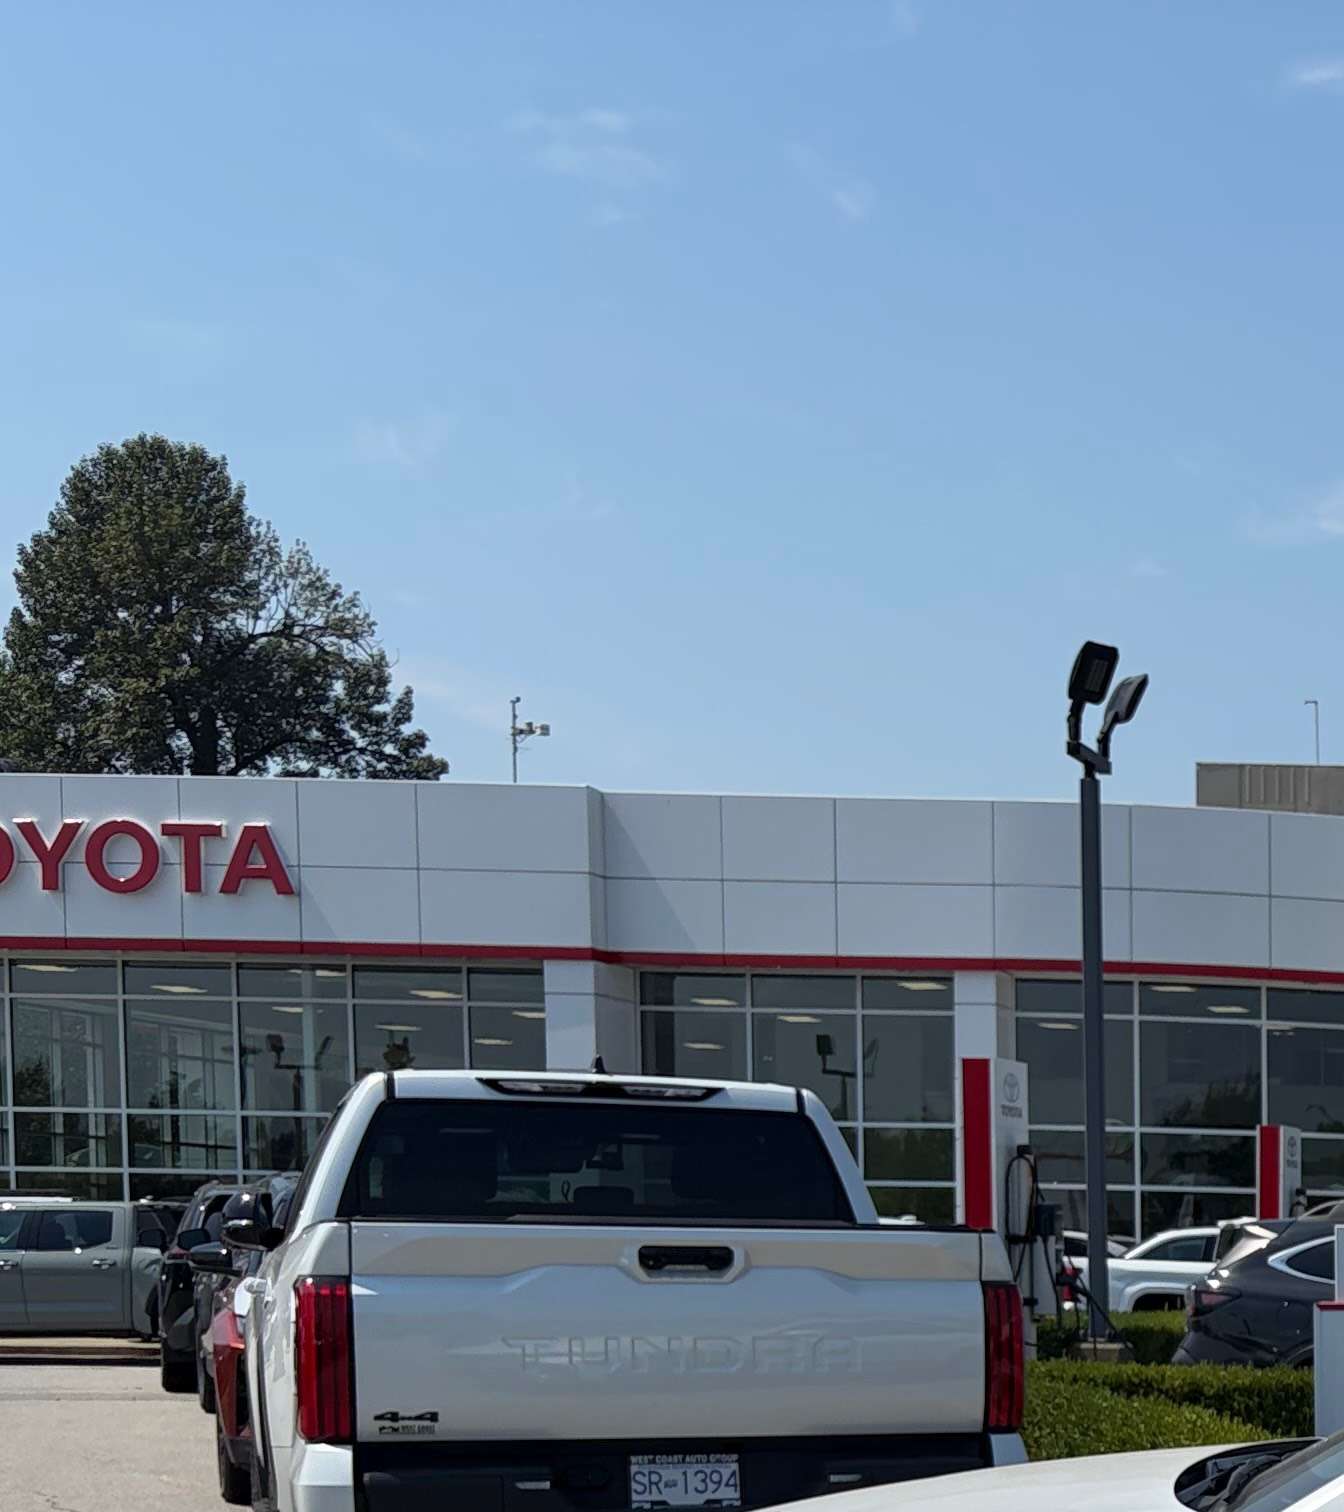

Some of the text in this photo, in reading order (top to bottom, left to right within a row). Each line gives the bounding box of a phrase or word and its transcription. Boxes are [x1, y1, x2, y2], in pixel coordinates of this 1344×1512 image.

[0, 818, 296, 896] YOTA
[501, 1335, 864, 1373] TUNDRA
[630, 1453, 739, 1465] WEST COAST AUTO GROUP
[632, 1469, 738, 1496] SR 1394
